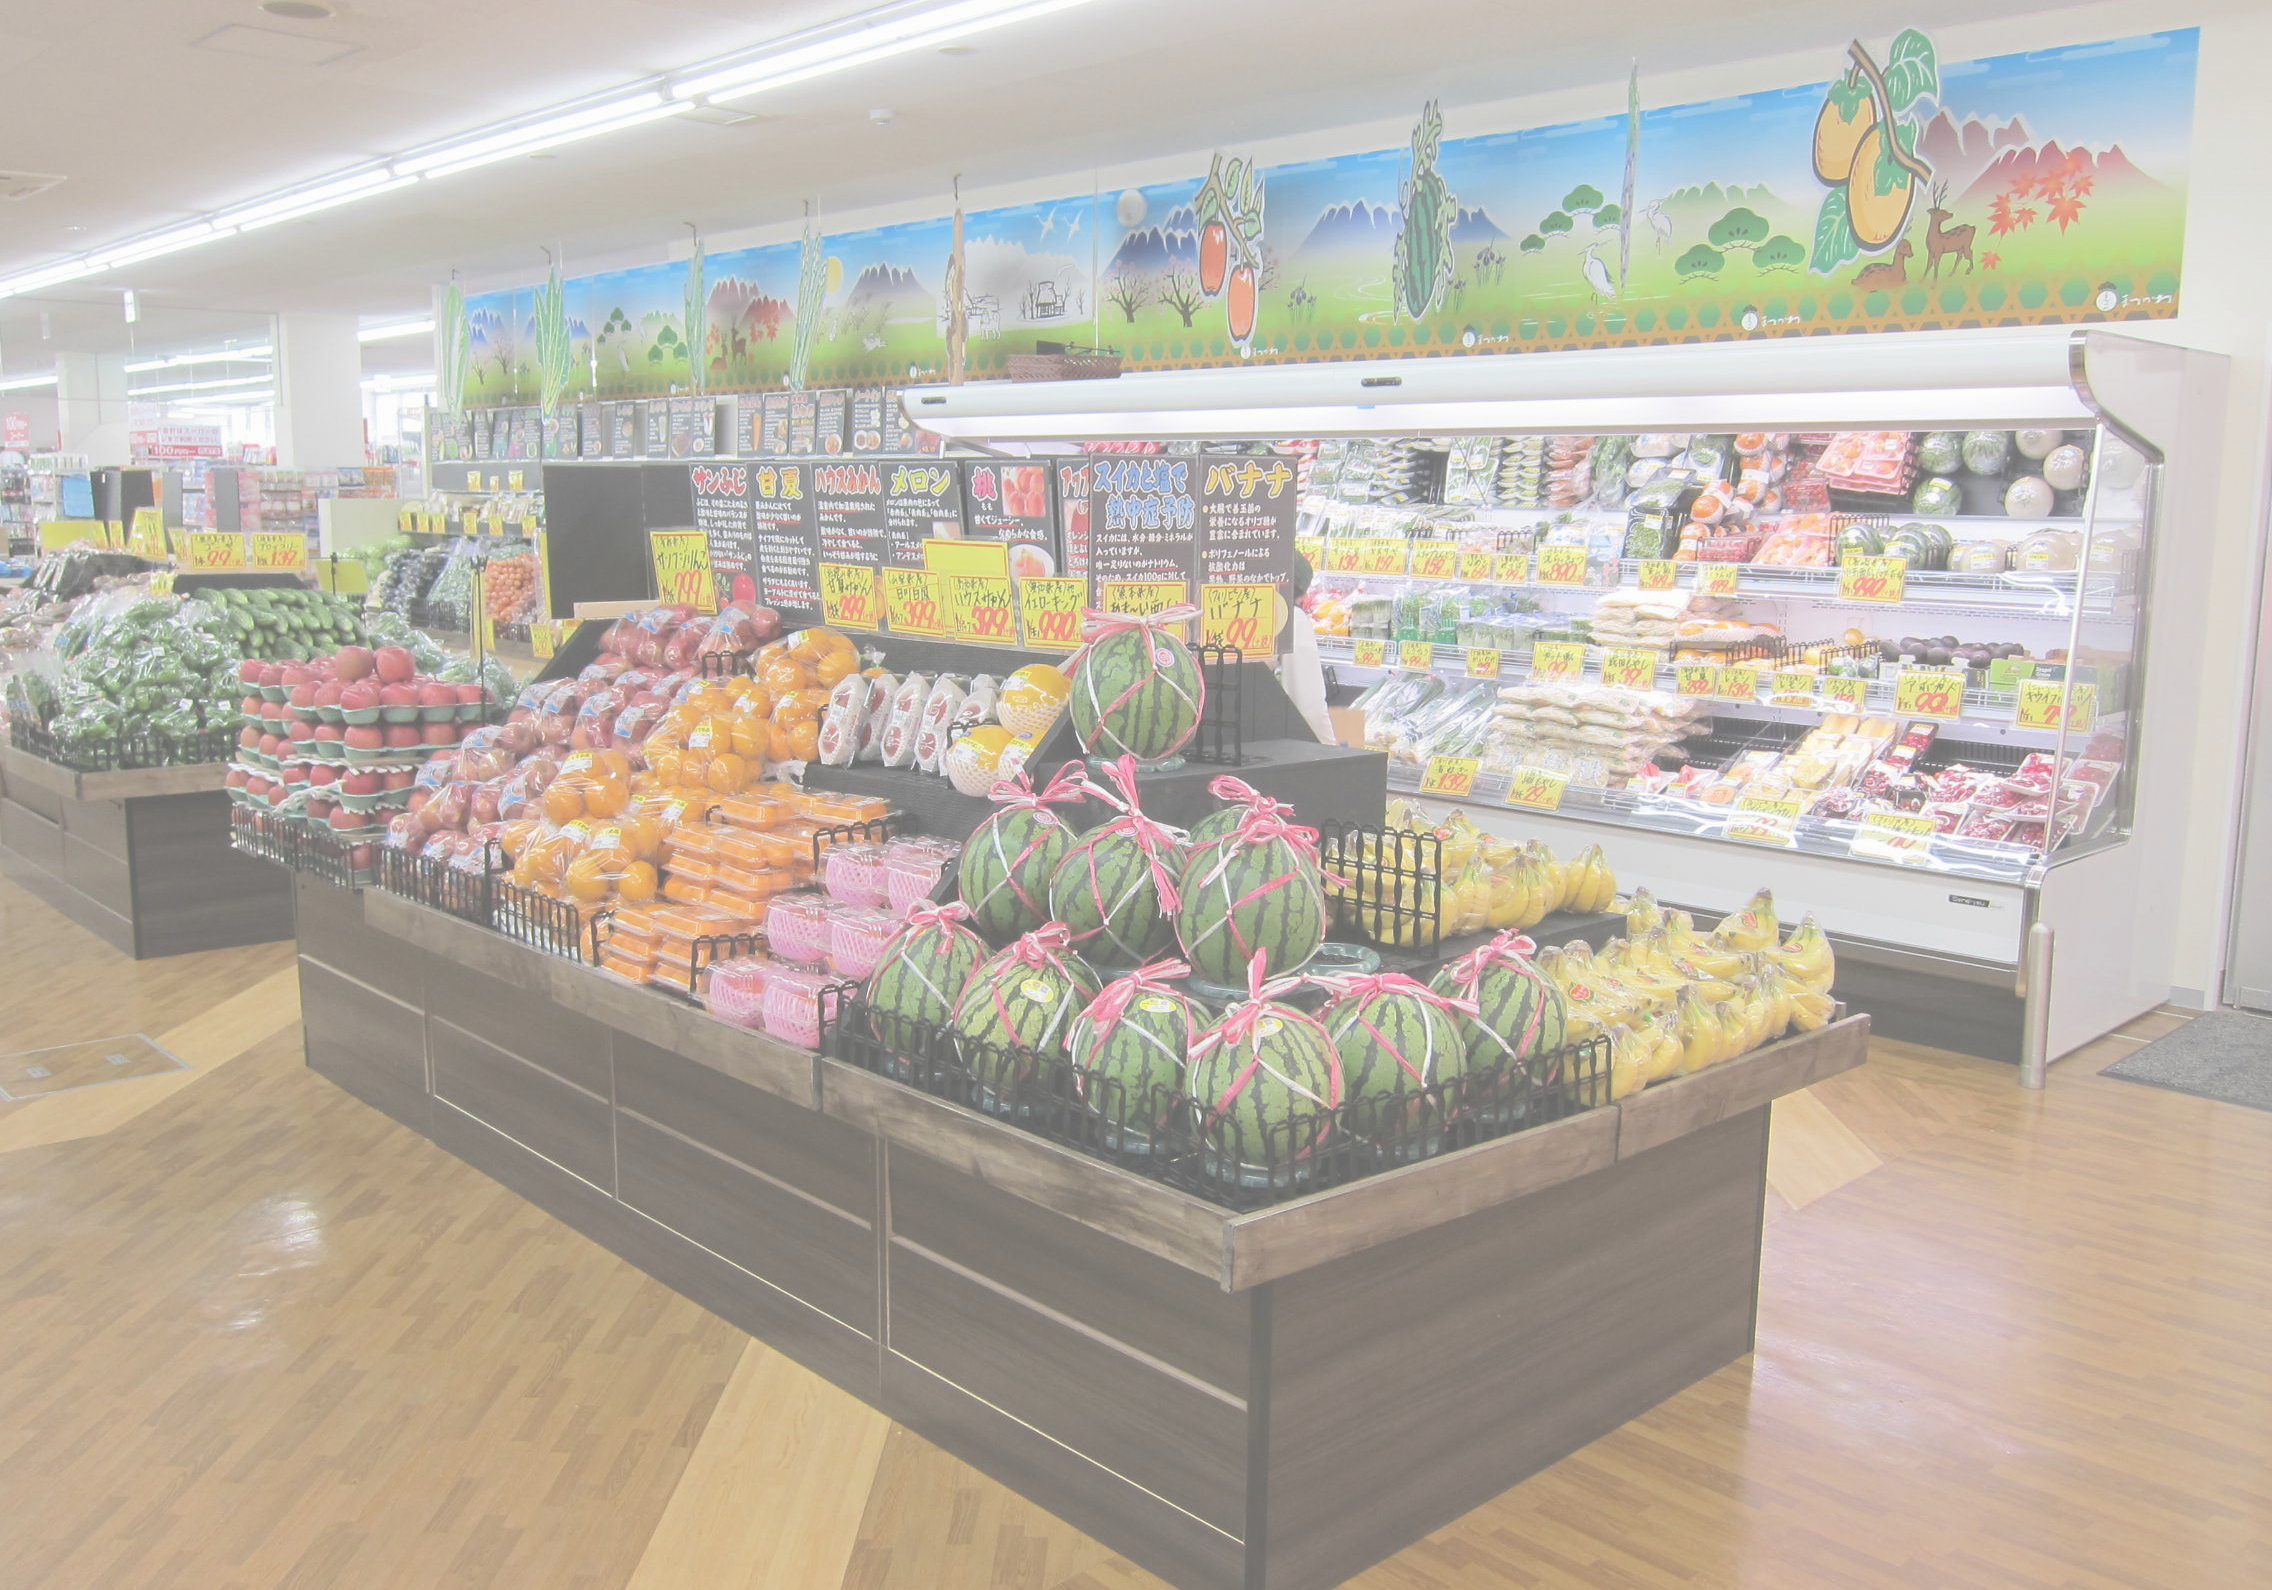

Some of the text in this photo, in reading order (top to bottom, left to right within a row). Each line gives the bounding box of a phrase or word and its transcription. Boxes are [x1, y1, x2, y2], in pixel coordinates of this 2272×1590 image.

[692, 466, 746, 496] サンふじ
[756, 466, 803, 499] 甘夏
[815, 465, 881, 496] ハウスみかん
[890, 465, 950, 497] メロン
[971, 466, 998, 501] 桃
[1093, 459, 1188, 495] スイカと塩で
[1204, 460, 1293, 499] バナナ
[981, 503, 993, 511] もも
[1105, 494, 1195, 530] 熱中症予防
[902, 600, 937, 628] 399
[971, 606, 1009, 635] 399
[1210, 598, 1262, 620] バナナ
[1039, 610, 1077, 640] 990
[1226, 617, 1258, 648] 99
